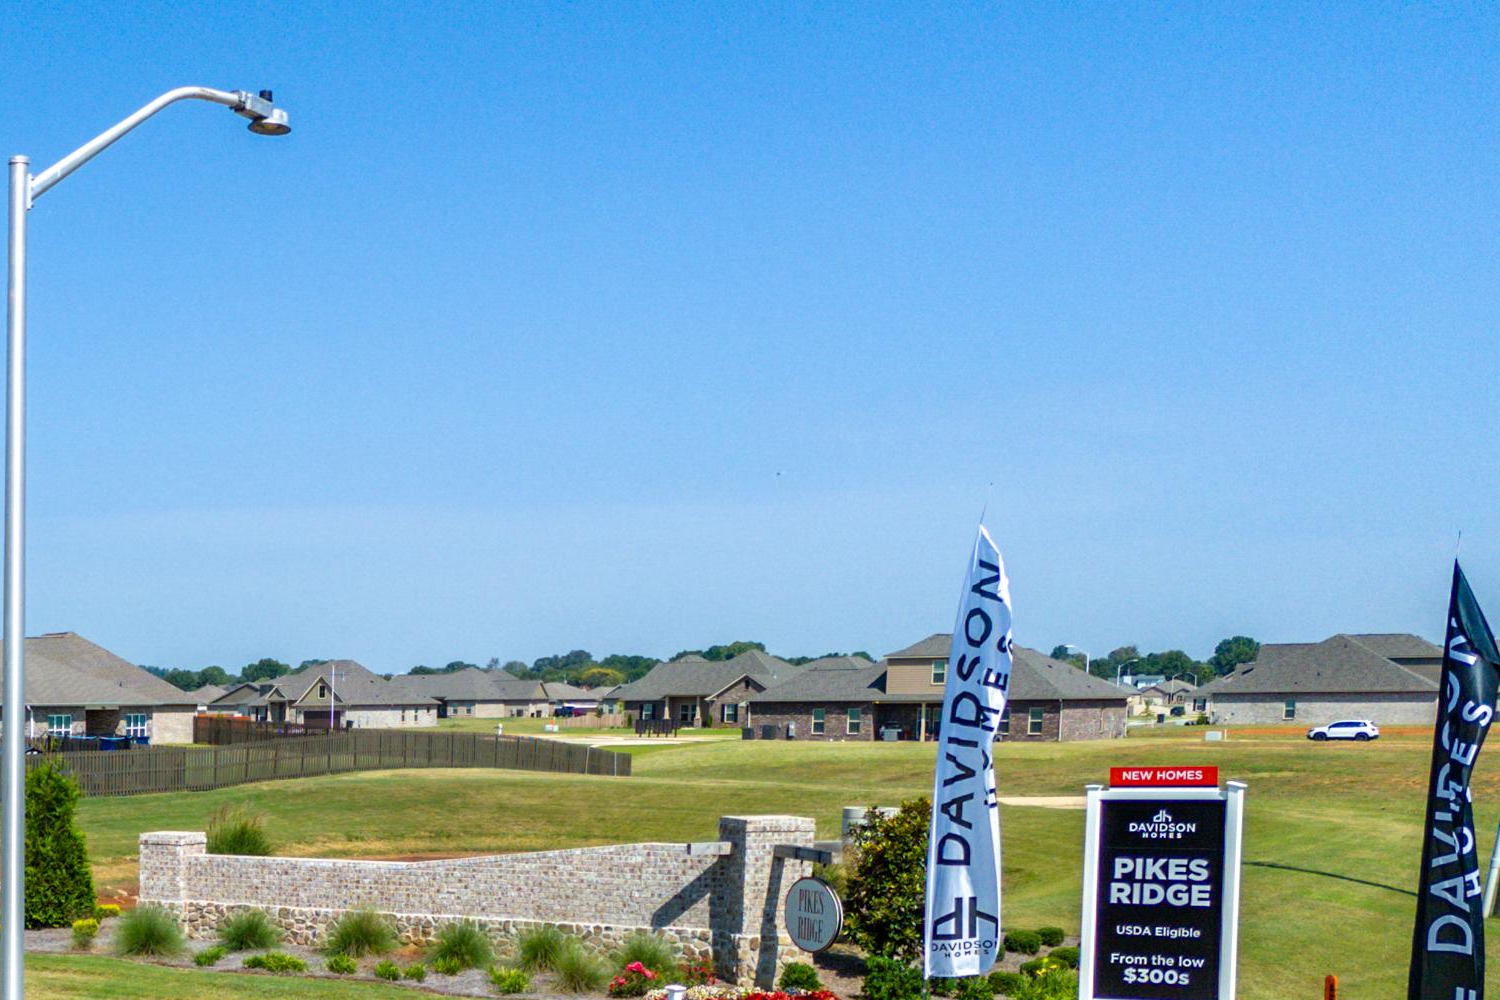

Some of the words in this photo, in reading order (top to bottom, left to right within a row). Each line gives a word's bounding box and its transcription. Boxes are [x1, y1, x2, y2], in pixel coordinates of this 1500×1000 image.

[937, 559, 1003, 866] DAVIDSON
[1122, 771, 1153, 780] NEW
[1157, 770, 1203, 780] HOMES
[1129, 823, 1196, 832] DAVIDSON
[1114, 857, 1209, 881] PIKES
[1110, 882, 1211, 907] RIDGE
[1116, 925, 1151, 936] USDA
[1155, 926, 1201, 939] Eligible
[931, 940, 998, 952] DAVIDSO
[944, 949, 990, 959] HOMES
[1110, 953, 1148, 965] From
[1151, 954, 1174, 966] the
[1179, 956, 1205, 968] low
[1123, 967, 1190, 985] $300s
